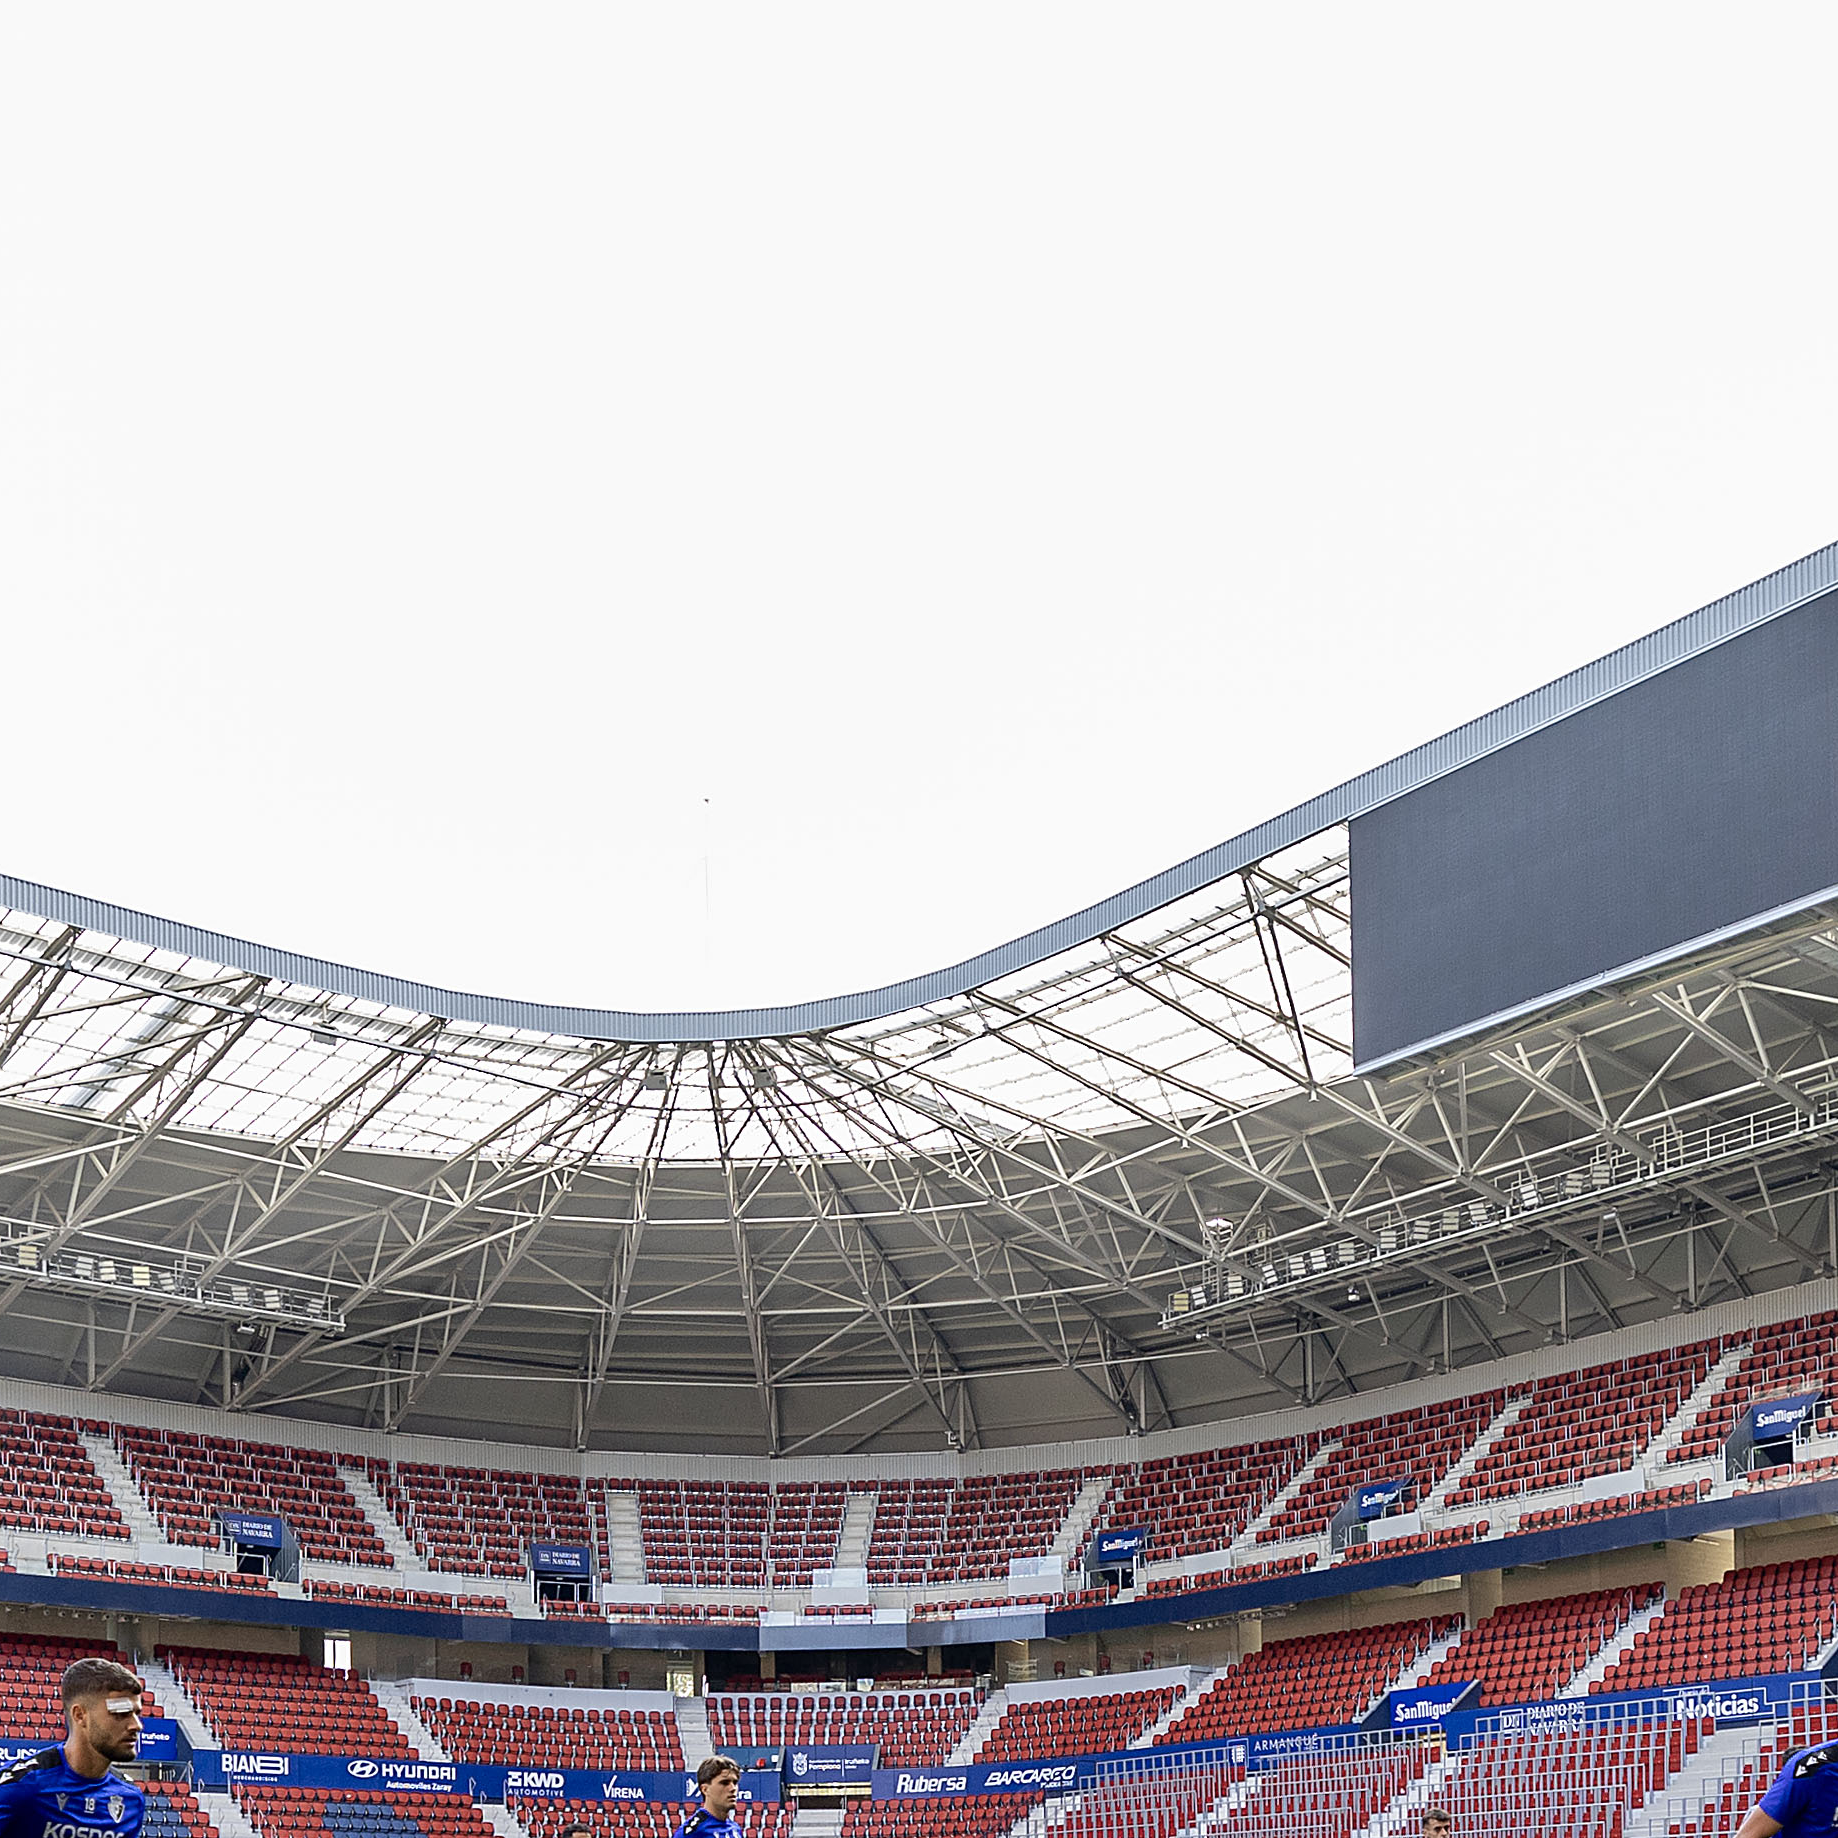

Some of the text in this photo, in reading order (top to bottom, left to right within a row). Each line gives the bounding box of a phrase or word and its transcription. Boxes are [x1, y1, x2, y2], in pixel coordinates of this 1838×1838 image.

[1755, 1405, 1807, 1428] SanMiguel
[1676, 1694, 1760, 1721] Noticias
[381, 1763, 456, 1781] HYUNDAI
[523, 1772, 565, 1788] KWD
[507, 1787, 565, 1797] AUTOMOTIVE
[602, 1775, 645, 1799] VIRENA
[896, 1772, 967, 1794] Rubersa
[84, 1797, 96, 1811] 18
